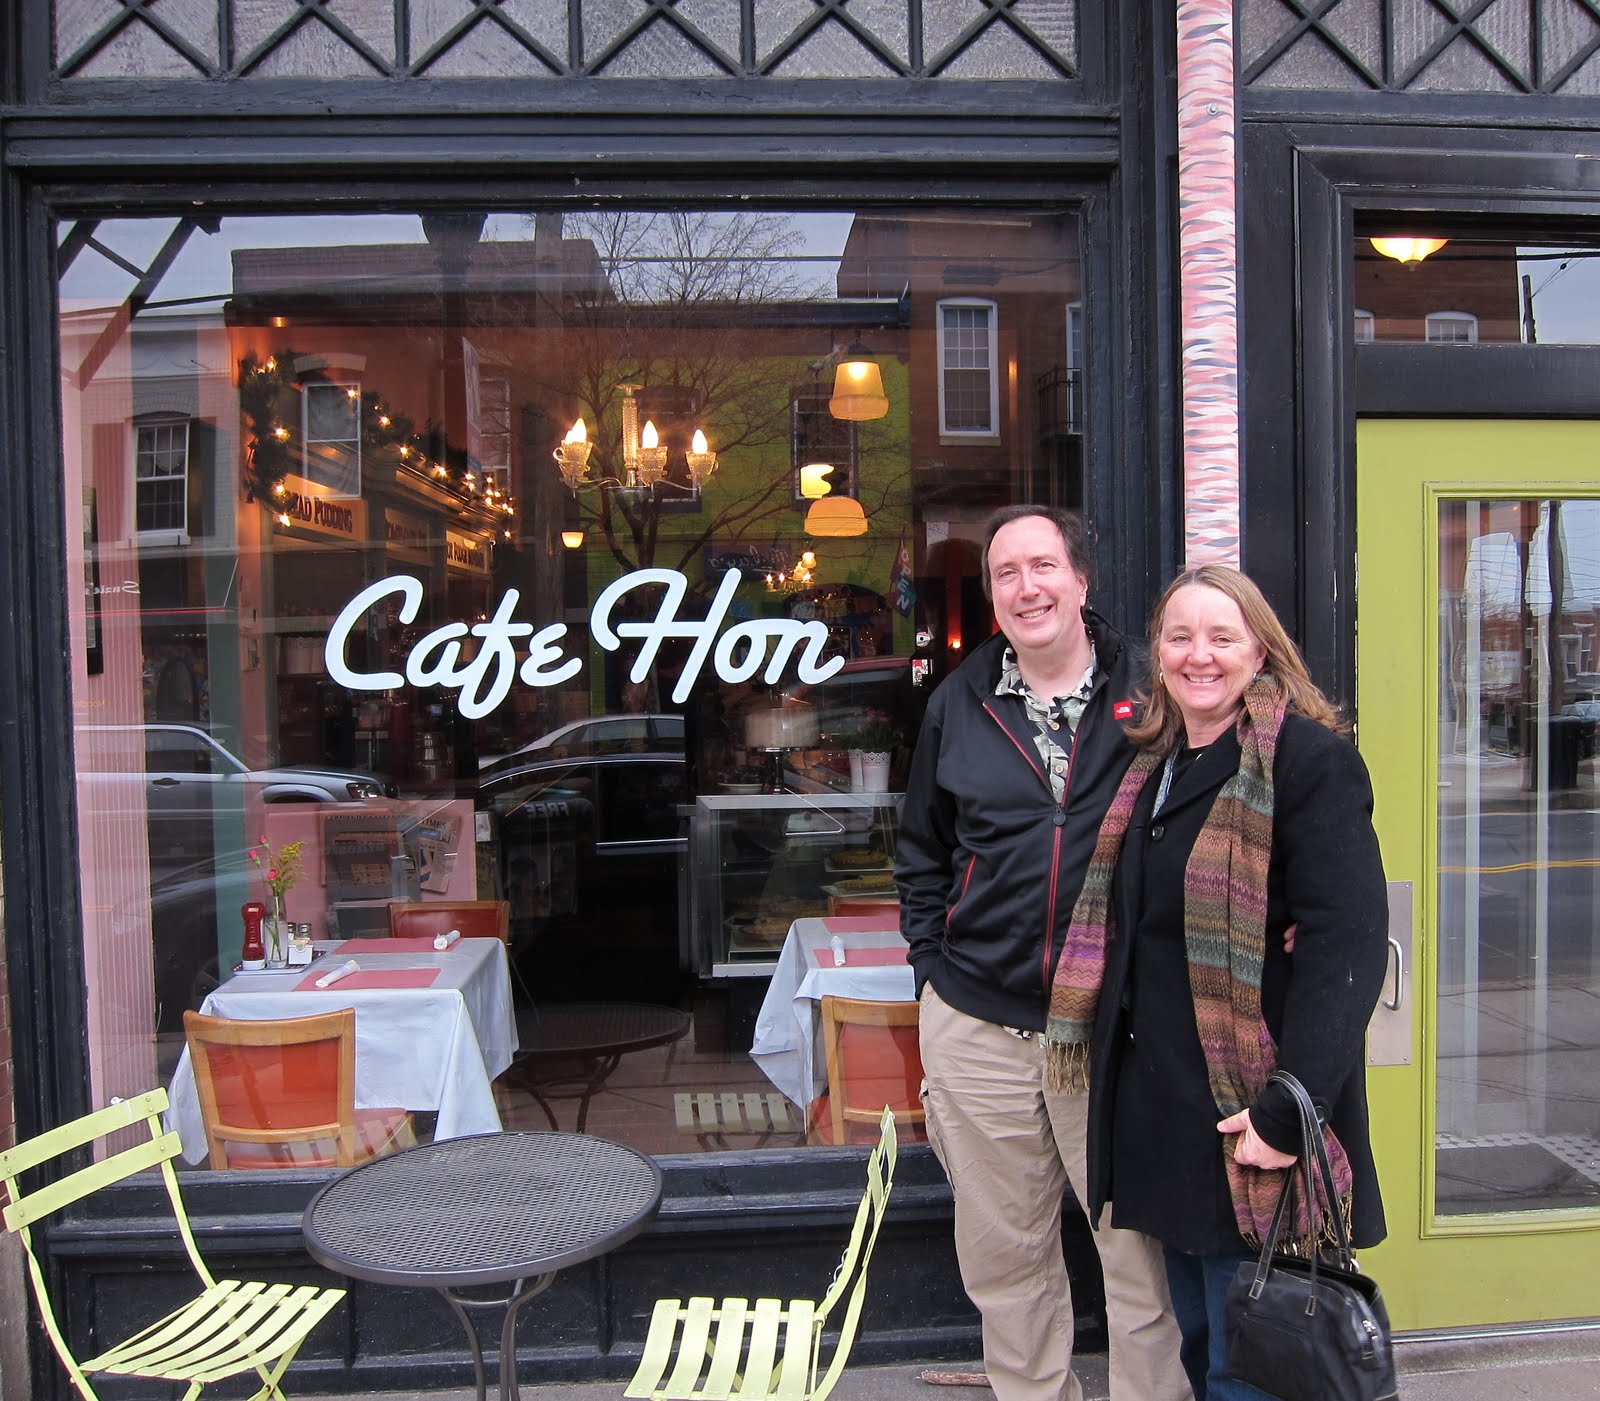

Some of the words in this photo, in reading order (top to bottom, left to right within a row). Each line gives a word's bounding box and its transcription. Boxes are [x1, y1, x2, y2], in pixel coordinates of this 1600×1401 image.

[314, 496, 353, 533] PUDDING
[895, 548, 912, 611] OPEN
[324, 575, 583, 720] Cafe
[590, 567, 846, 704] Hon
